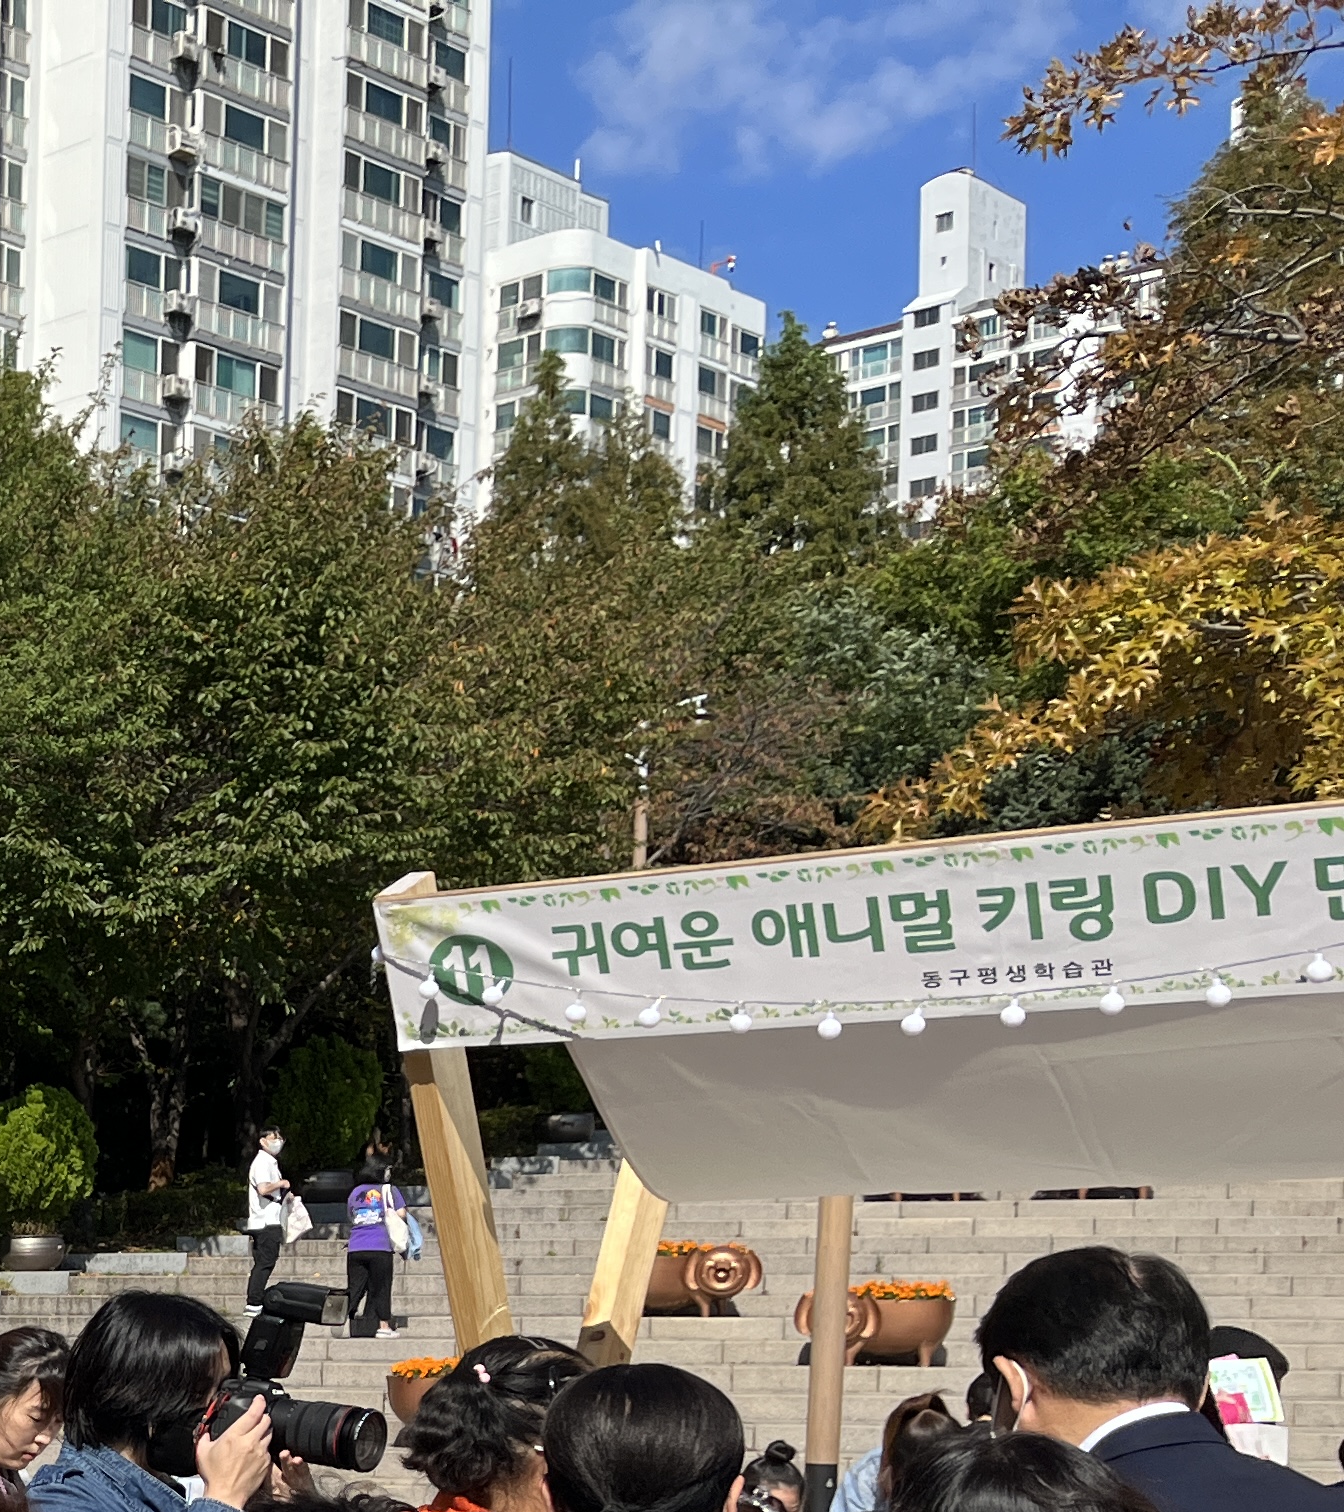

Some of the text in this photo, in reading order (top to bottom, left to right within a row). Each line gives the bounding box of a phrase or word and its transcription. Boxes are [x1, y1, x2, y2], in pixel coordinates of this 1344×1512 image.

[551, 909, 734, 976] 귀여운
[751, 889, 956, 958] 애니멀
[976, 874, 1114, 942] 키링
[1143, 860, 1288, 924] DIY
[442, 945, 495, 995] 11
[920, 957, 1114, 989] 동구평생학습관
